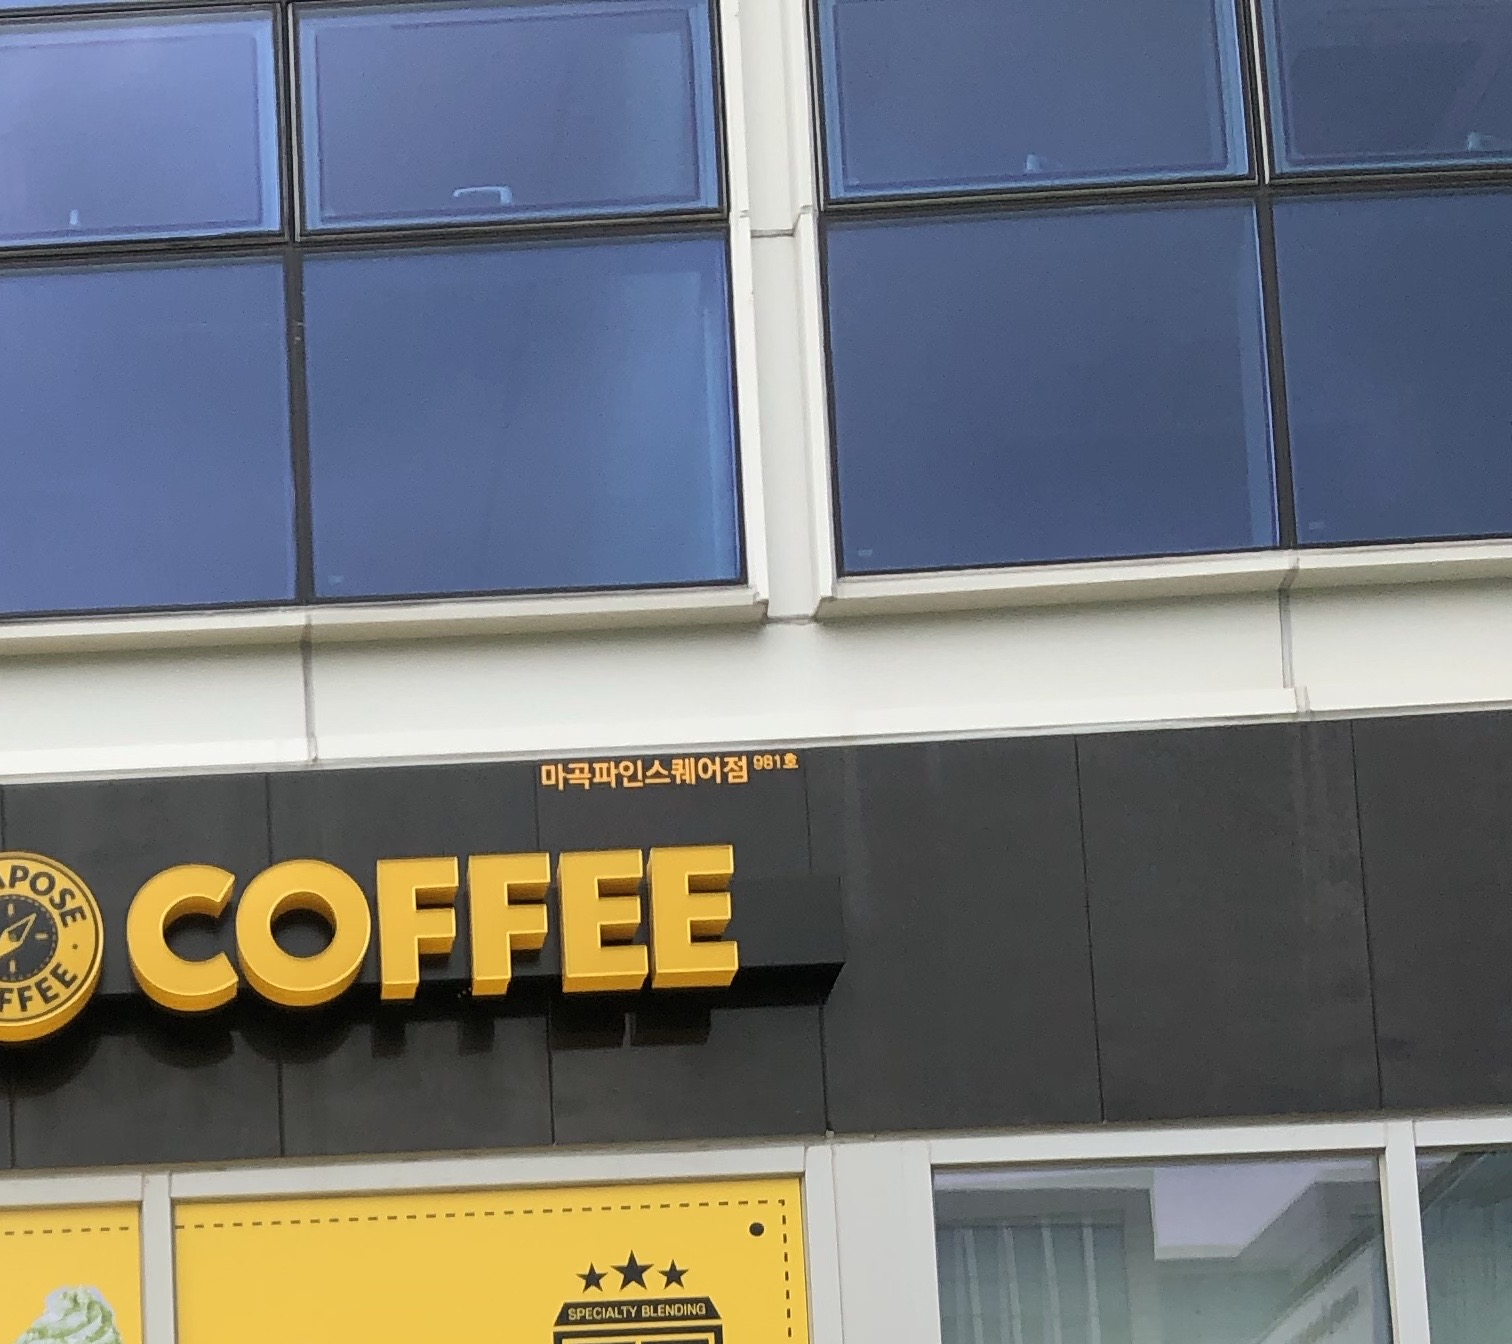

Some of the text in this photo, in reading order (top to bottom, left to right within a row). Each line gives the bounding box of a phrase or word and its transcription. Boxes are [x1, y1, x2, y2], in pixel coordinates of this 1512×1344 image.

[541, 755, 749, 790] 마곡파인스퀘어점
[126, 845, 738, 1014] COFFEE
[568, 1302, 706, 1322] SPECIALTY BLENDING
